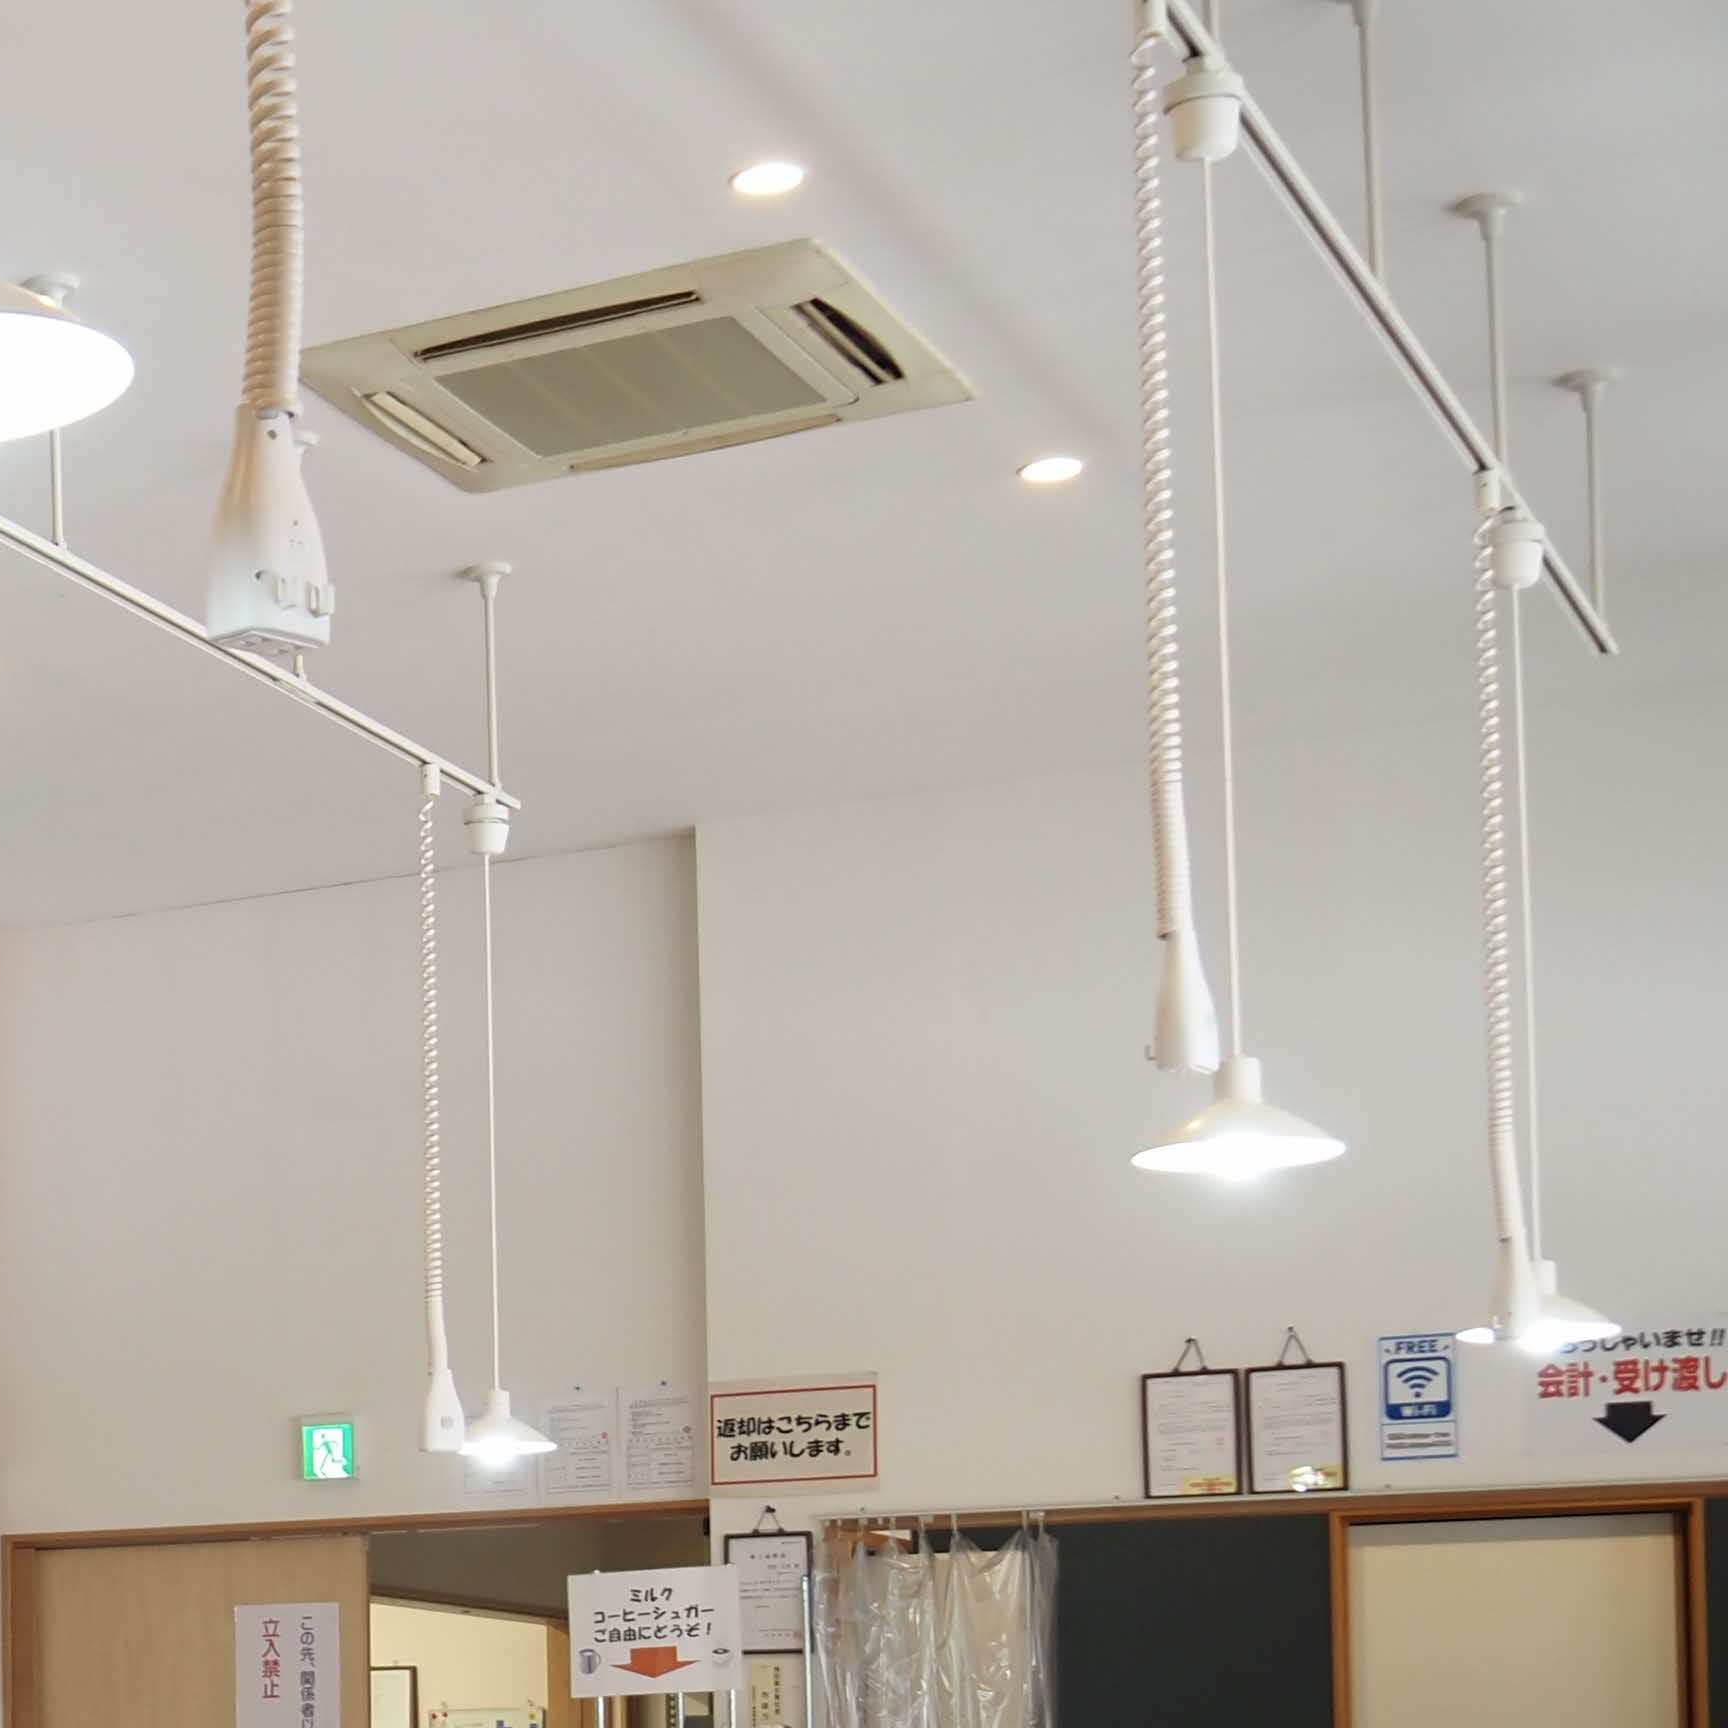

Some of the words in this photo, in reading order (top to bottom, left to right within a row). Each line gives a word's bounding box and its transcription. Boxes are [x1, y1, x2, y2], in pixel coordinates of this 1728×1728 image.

[1394, 1339, 1438, 1354] FREE
[717, 1411, 871, 1438] 返却はこちらまで
[730, 1438, 851, 1461] お願いします。
[630, 1588, 673, 1602] ミルク
[594, 1604, 714, 1624] コーヒーシュガー
[262, 1618, 280, 1699] 立入禁止
